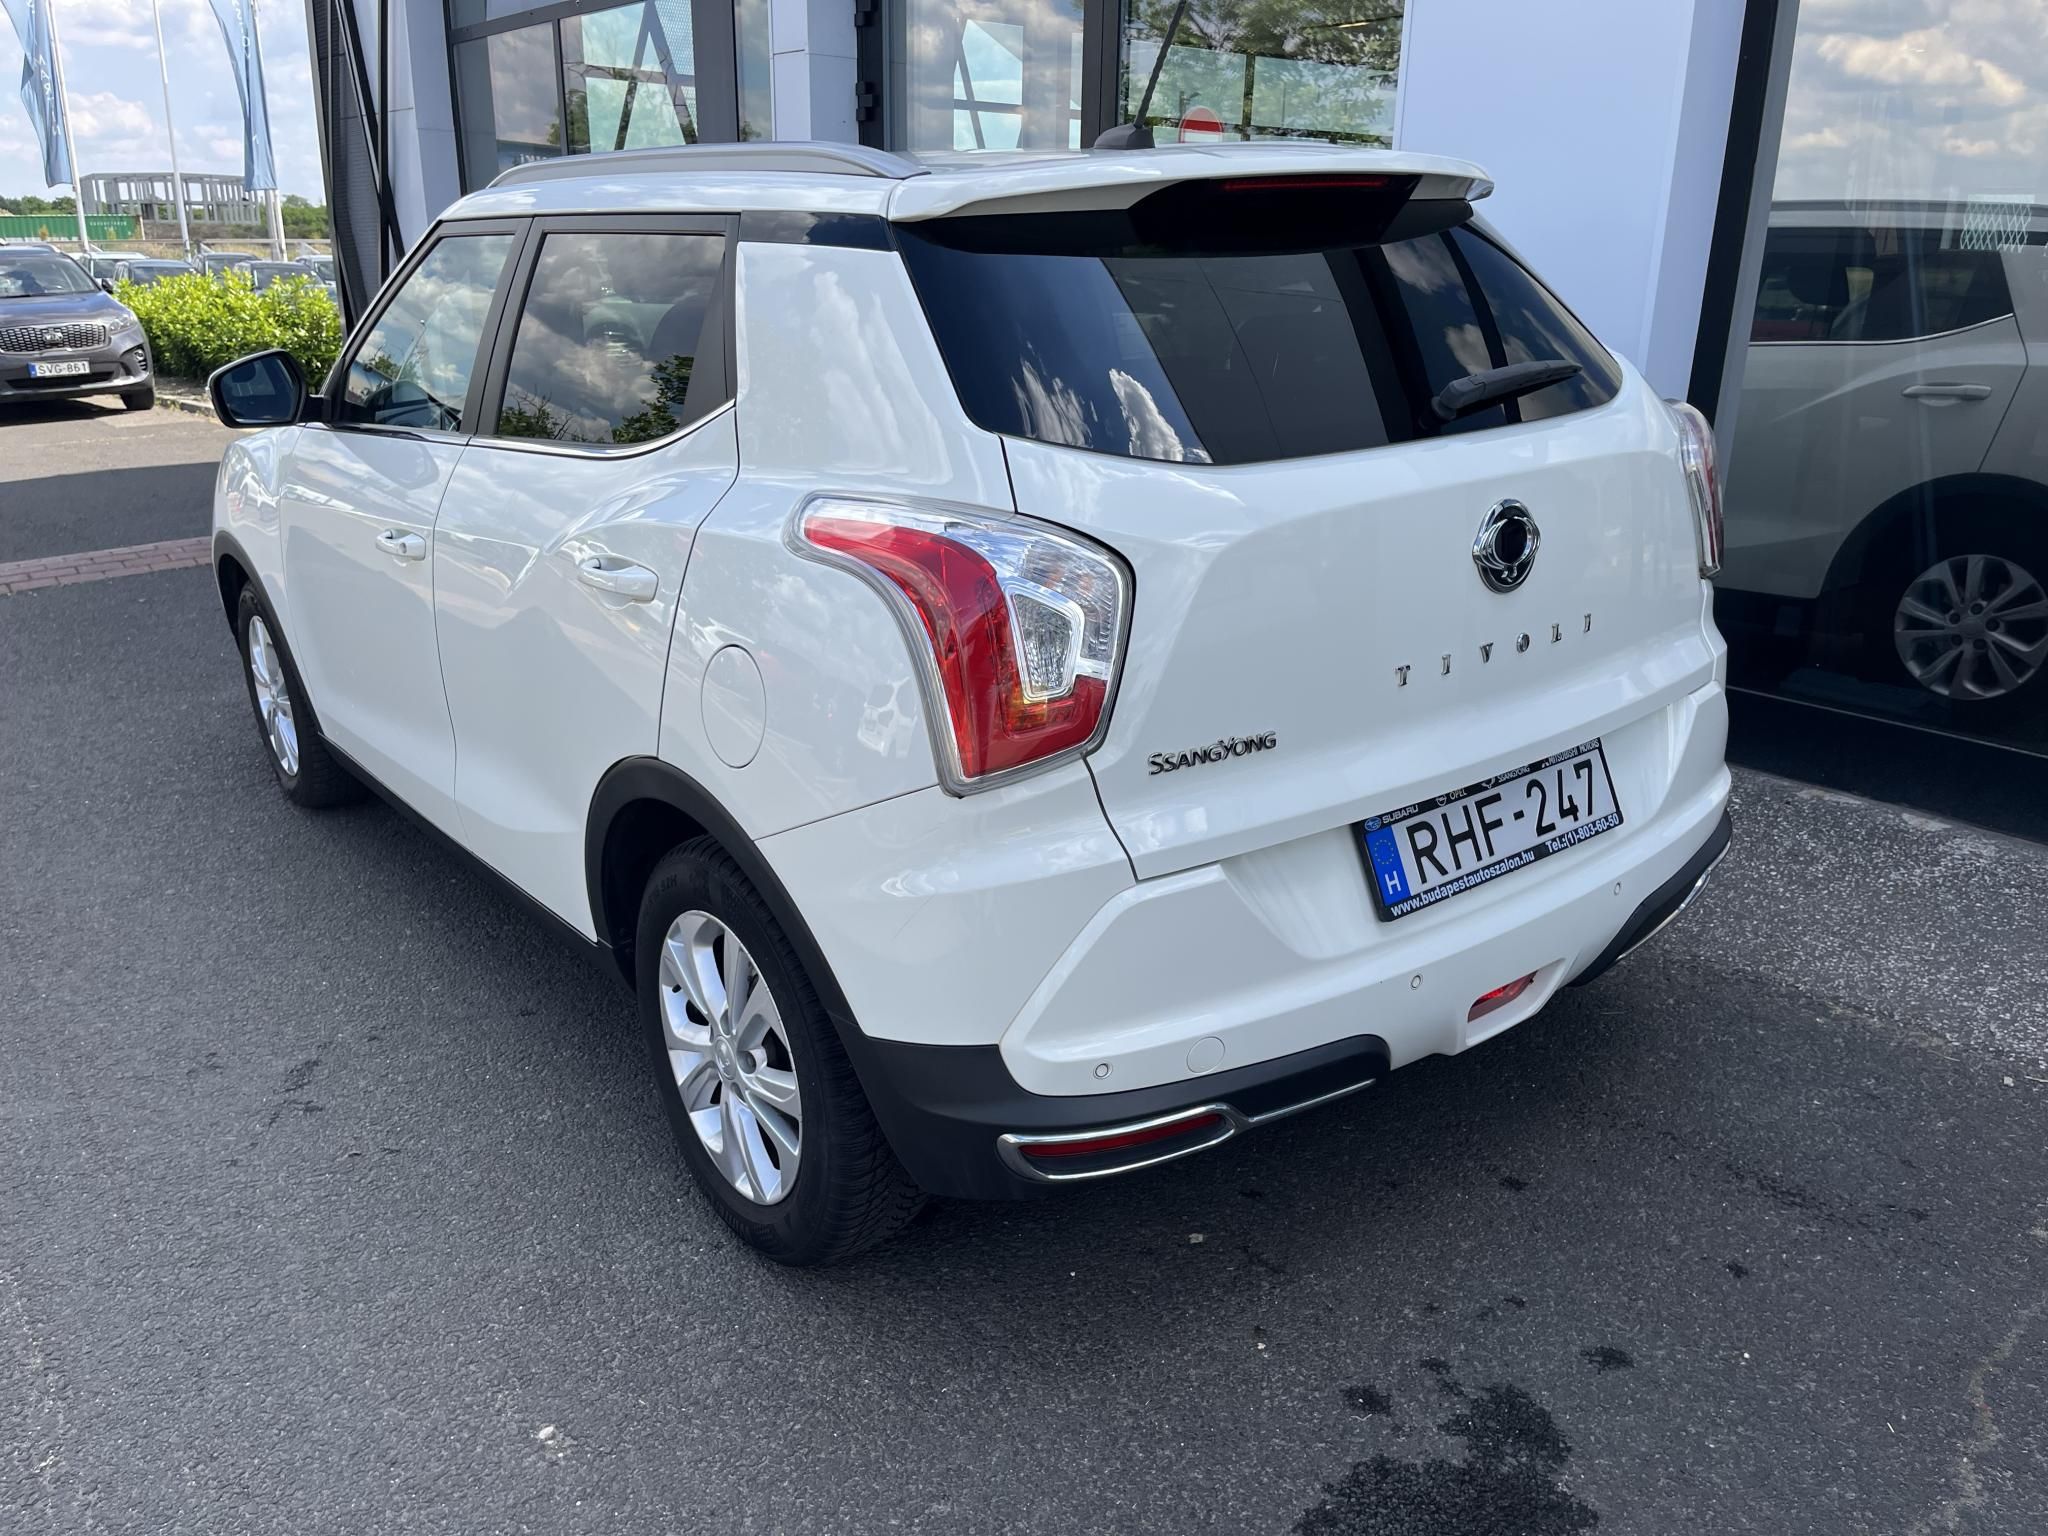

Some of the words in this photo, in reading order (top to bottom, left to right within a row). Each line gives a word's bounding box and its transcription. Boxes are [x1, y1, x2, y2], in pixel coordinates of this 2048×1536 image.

[38, 363, 87, 375] SVG-861
[1394, 613, 1592, 687] TIVOLI
[1382, 804, 1419, 824] SUBARU
[1449, 788, 1468, 801] OPEL
[1497, 765, 1531, 783] SSANGYONG
[1548, 747, 1579, 767] MITSUBISHI
[1579, 739, 1600, 753] MOTORS
[1406, 758, 1594, 885] RHF-247
[1384, 873, 1402, 895] H
[1391, 849, 1536, 917] www.budapestautoszalon.hu
